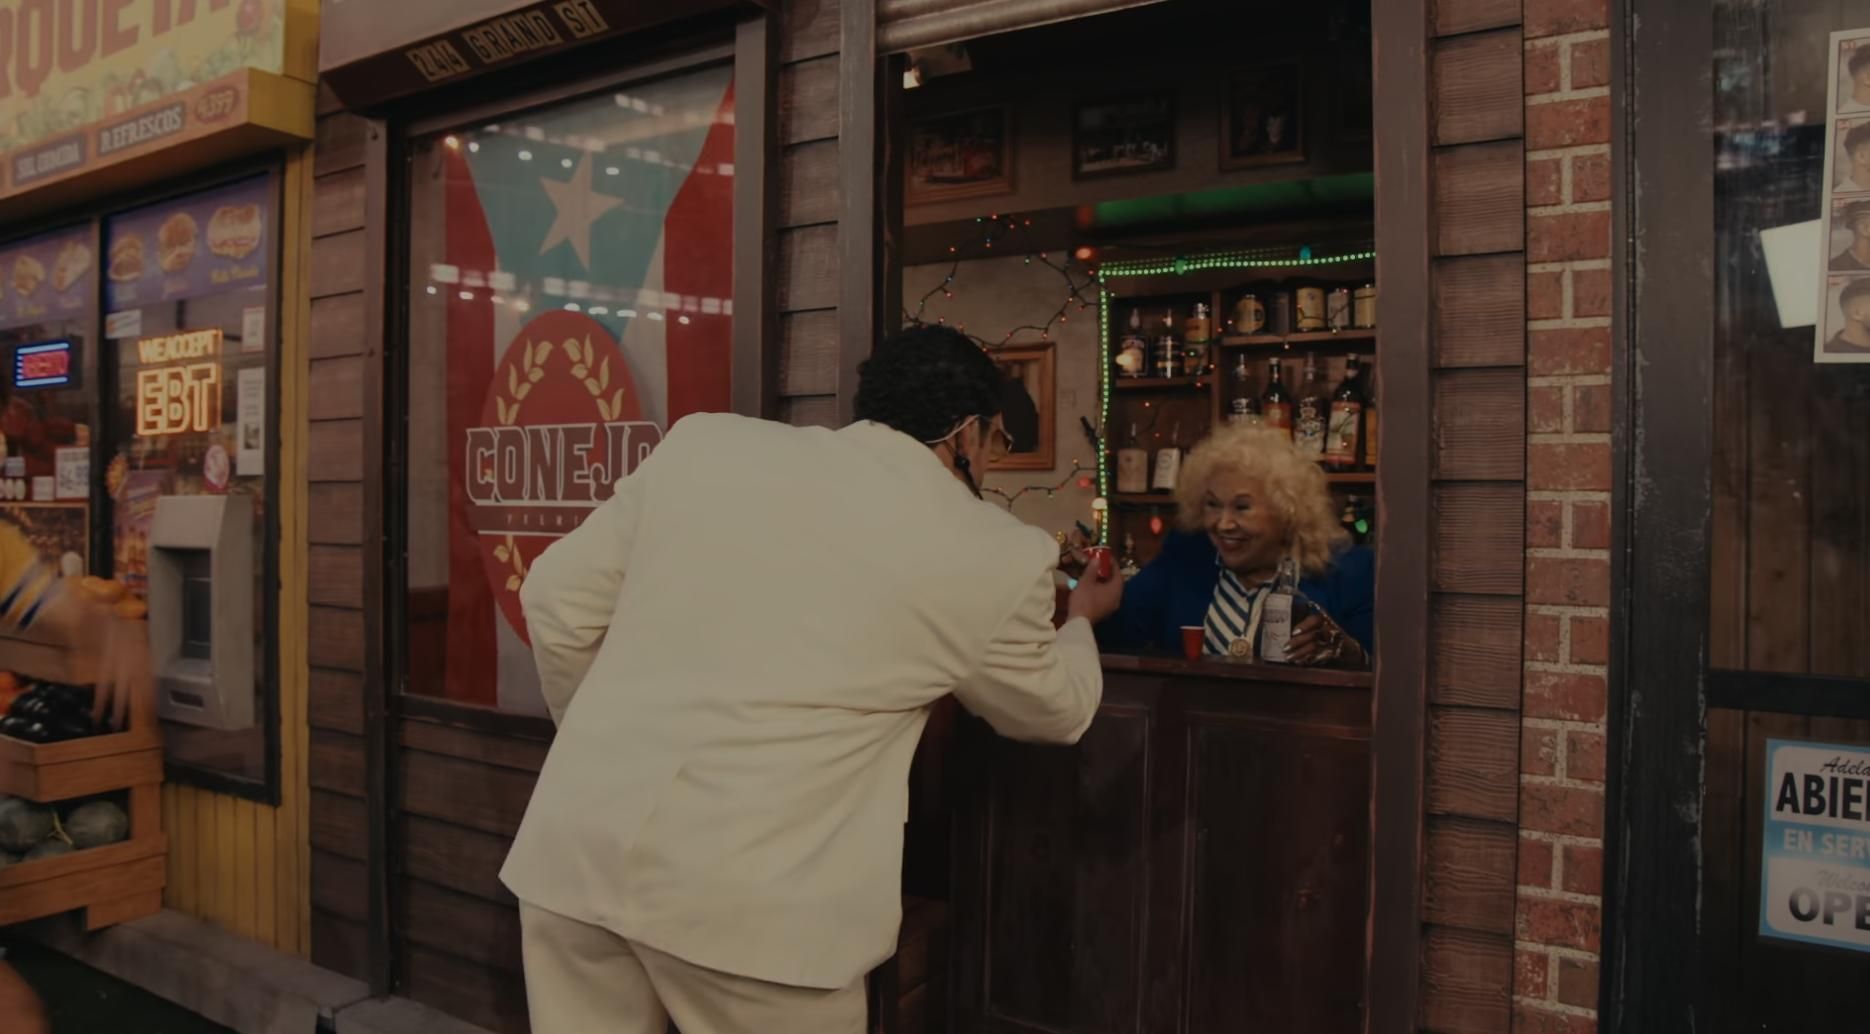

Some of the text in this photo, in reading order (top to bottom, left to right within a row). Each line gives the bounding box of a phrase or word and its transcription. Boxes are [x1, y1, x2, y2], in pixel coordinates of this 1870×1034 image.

[467, 15, 556, 60] GRAND
[562, 1, 601, 33] ST
[99, 106, 183, 154] REFRESCOS
[138, 329, 219, 364] WE ACCEPT
[136, 362, 217, 436] EBT
[1776, 771, 1870, 821] ABIE
[1783, 828, 1814, 852] EN
